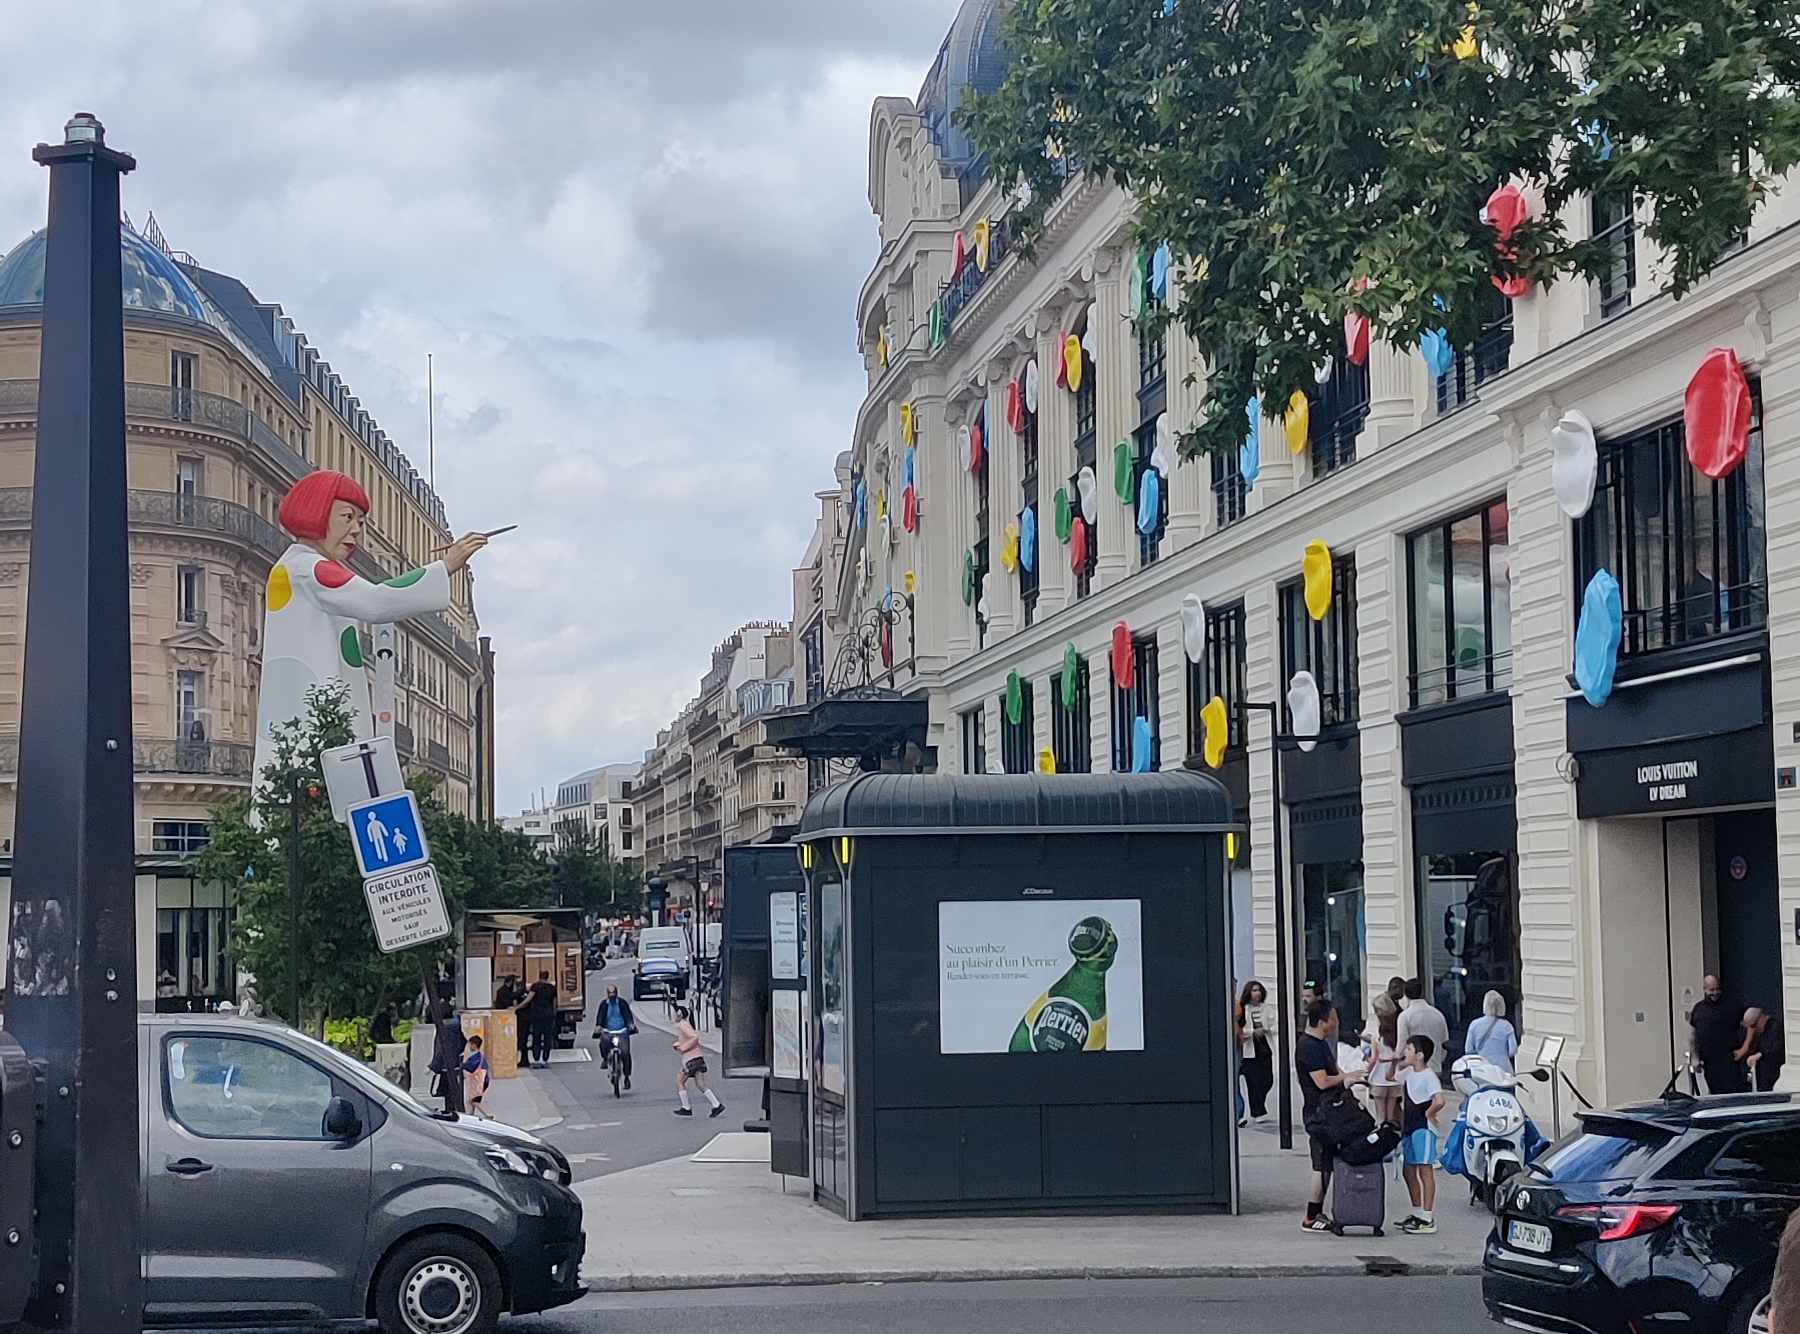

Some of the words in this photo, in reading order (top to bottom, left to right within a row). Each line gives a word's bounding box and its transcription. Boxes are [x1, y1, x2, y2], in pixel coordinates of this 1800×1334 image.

[1637, 765, 1661, 784] LOUIS
[1661, 760, 1698, 780] VUITTON
[1649, 786, 1658, 801] LV
[1659, 783, 1686, 800] DREAM
[369, 870, 431, 894] CIRCULATION
[378, 884, 428, 905] INTERDITE
[382, 907, 395, 915] AUX
[403, 921, 419, 931] SAUF
[385, 932, 417, 947] DESSERTE
[419, 925, 443, 937] LOCALE
[946, 942, 1006, 954] Succombez
[946, 959, 959, 968] au
[961, 957, 993, 971] plaisir
[996, 956, 1018, 967] d'un
[1022, 955, 1060, 967] Perrier.
